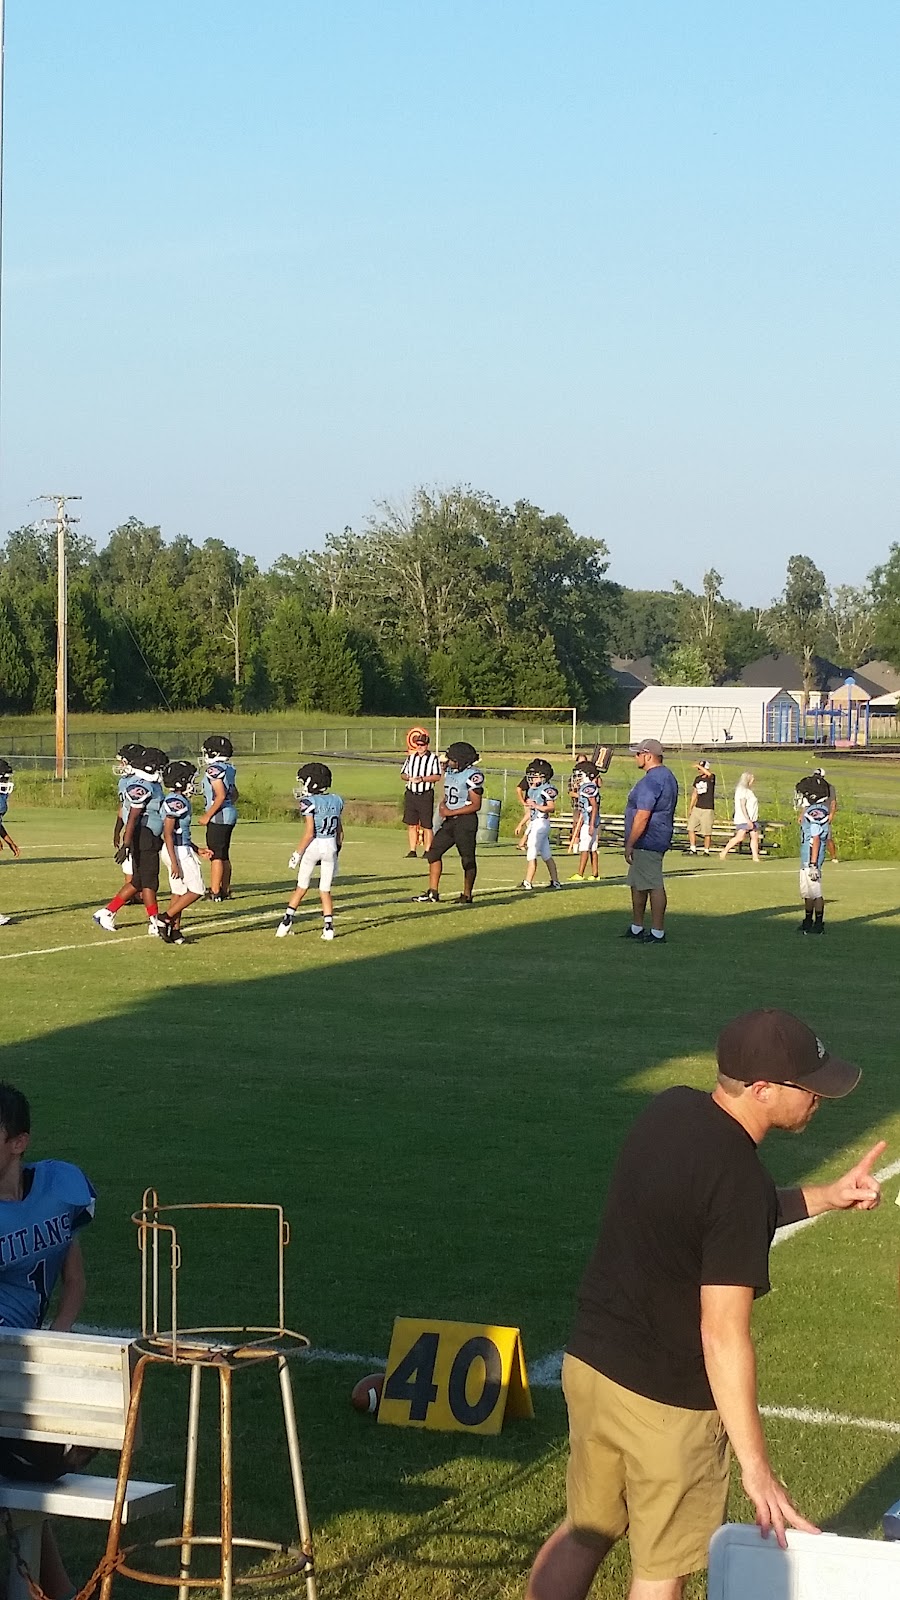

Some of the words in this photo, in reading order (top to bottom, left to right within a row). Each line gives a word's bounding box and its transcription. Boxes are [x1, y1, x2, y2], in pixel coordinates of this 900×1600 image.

[595, 747, 608, 767] 1
[0, 1213, 72, 1267] TITANS
[384, 1332, 503, 1426] 40
